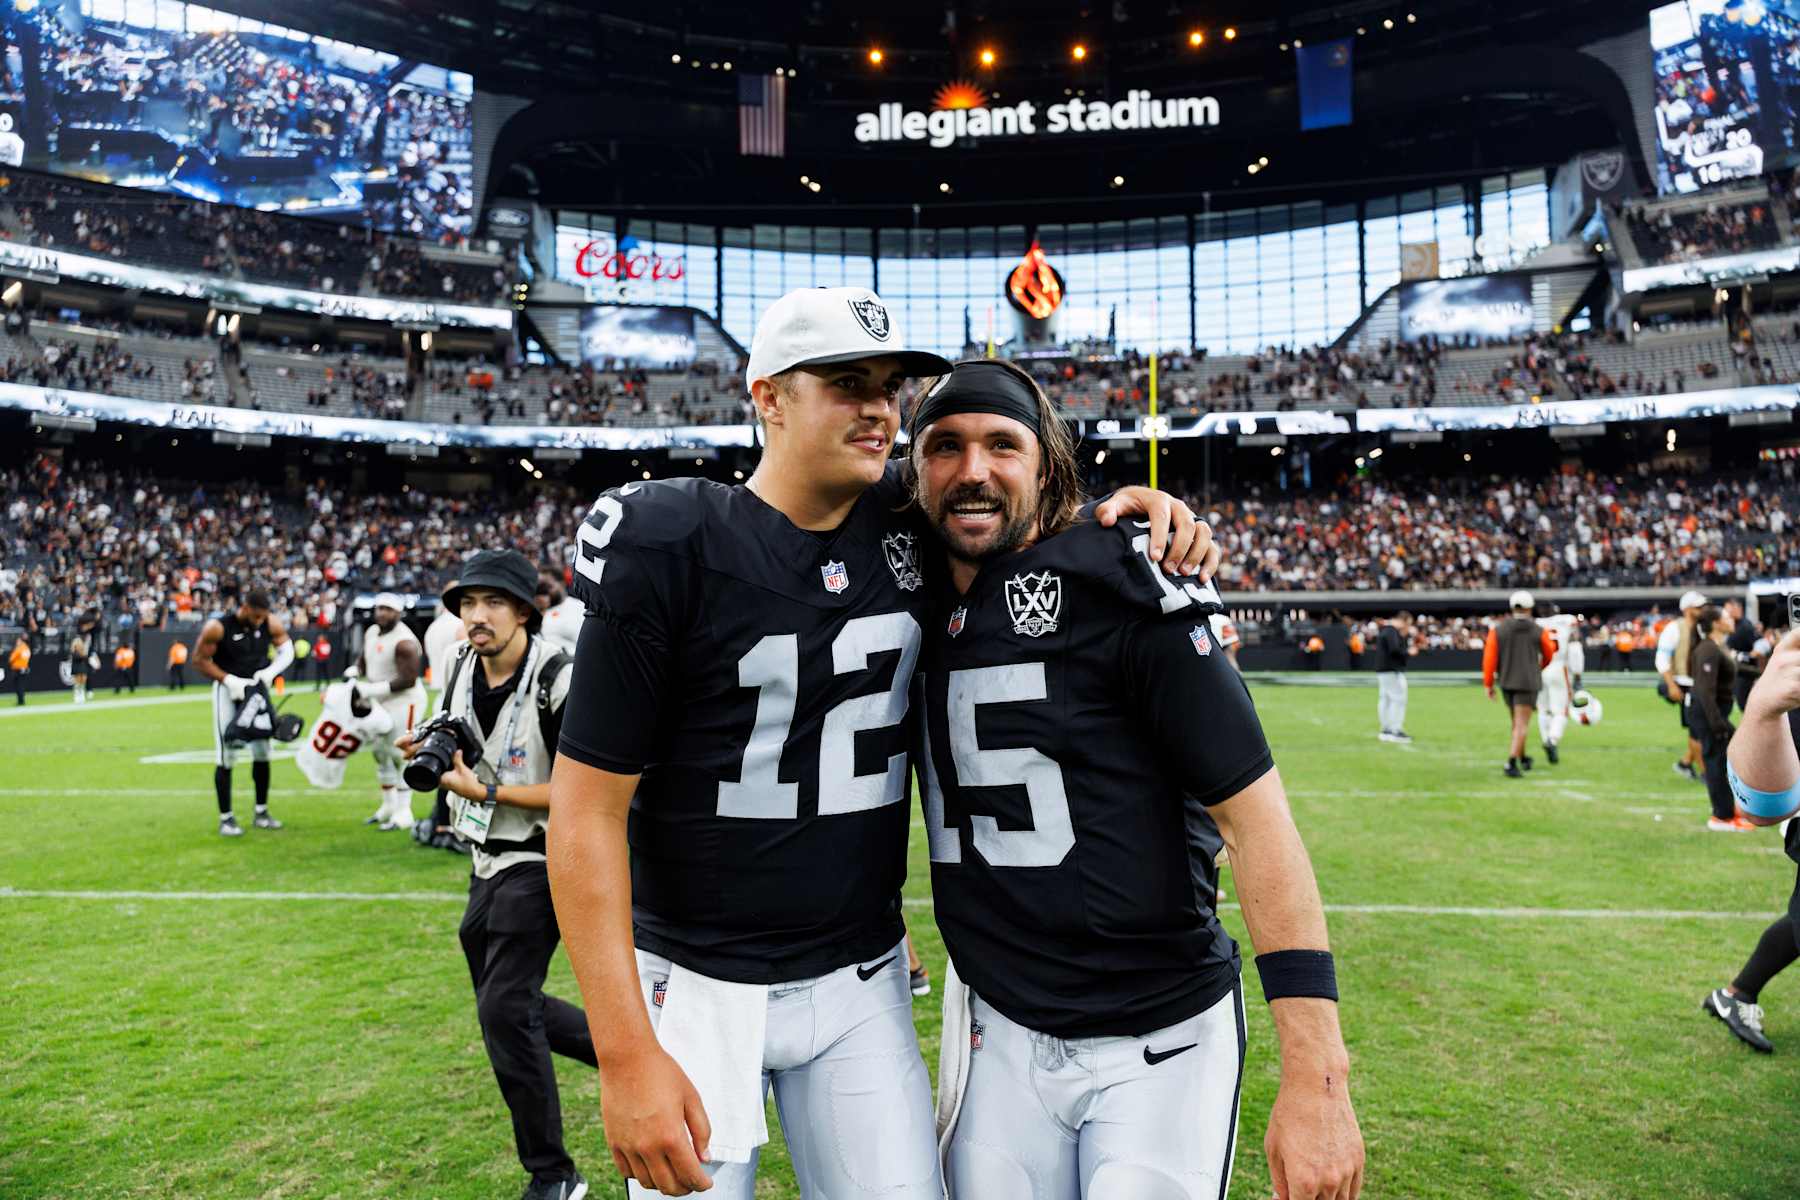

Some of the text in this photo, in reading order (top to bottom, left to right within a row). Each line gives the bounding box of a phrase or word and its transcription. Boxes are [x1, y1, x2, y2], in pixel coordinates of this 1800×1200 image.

[855, 89, 1220, 148] allegiant stadium
[574, 239, 685, 281] Coors
[827, 574, 845, 588] NFL
[1013, 591, 1057, 611] LXV
[716, 611, 921, 819] 12
[313, 720, 362, 759] 92
[917, 662, 1076, 866] 15
